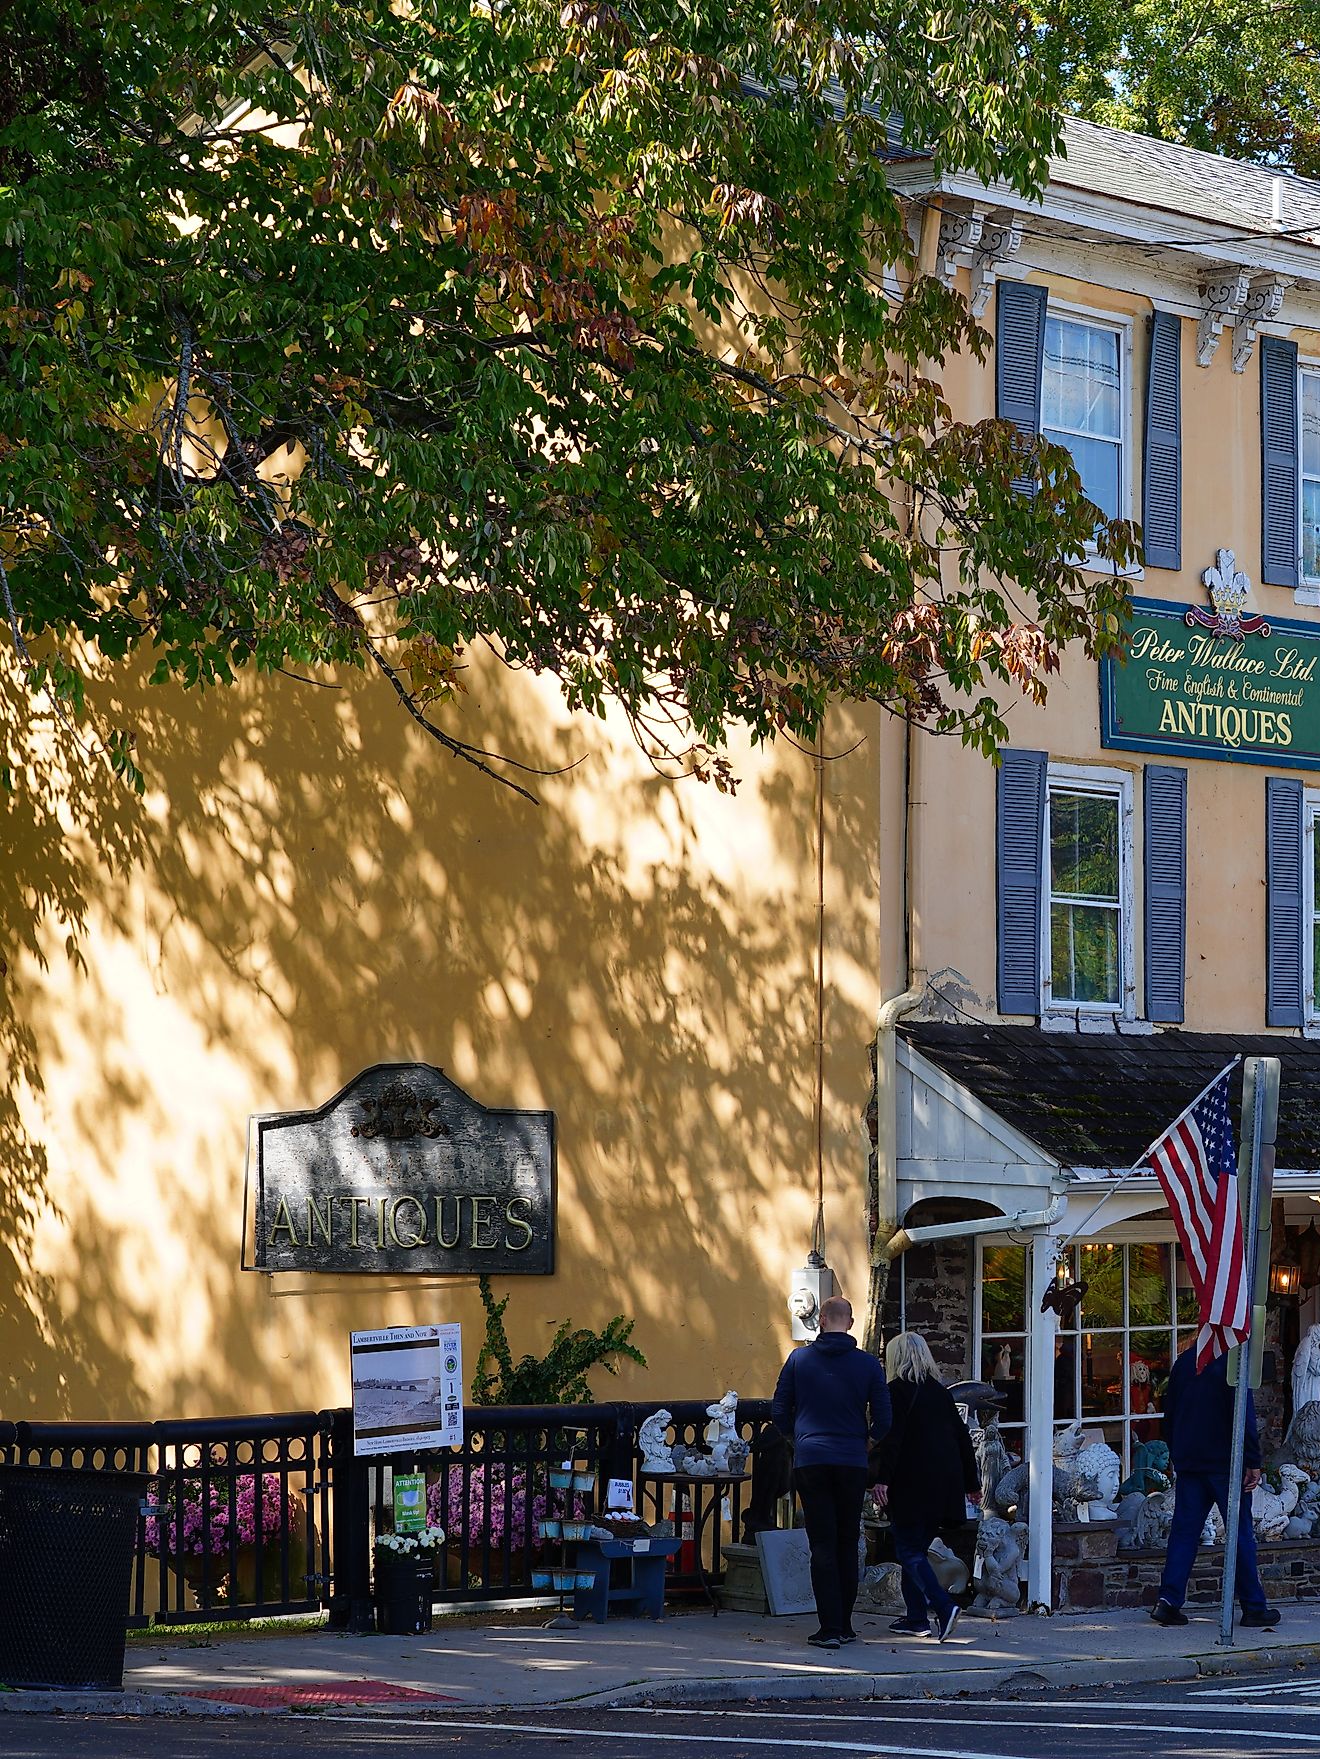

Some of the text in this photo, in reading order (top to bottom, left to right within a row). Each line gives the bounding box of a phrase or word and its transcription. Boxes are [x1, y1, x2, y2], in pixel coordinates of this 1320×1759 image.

[1129, 627, 1319, 682] Peter Wallace Ltd.
[1145, 668, 1304, 707] Fine English & Continental
[1158, 699, 1293, 748] ANTIQUES
[266, 1193, 534, 1251] ANTIQUES
